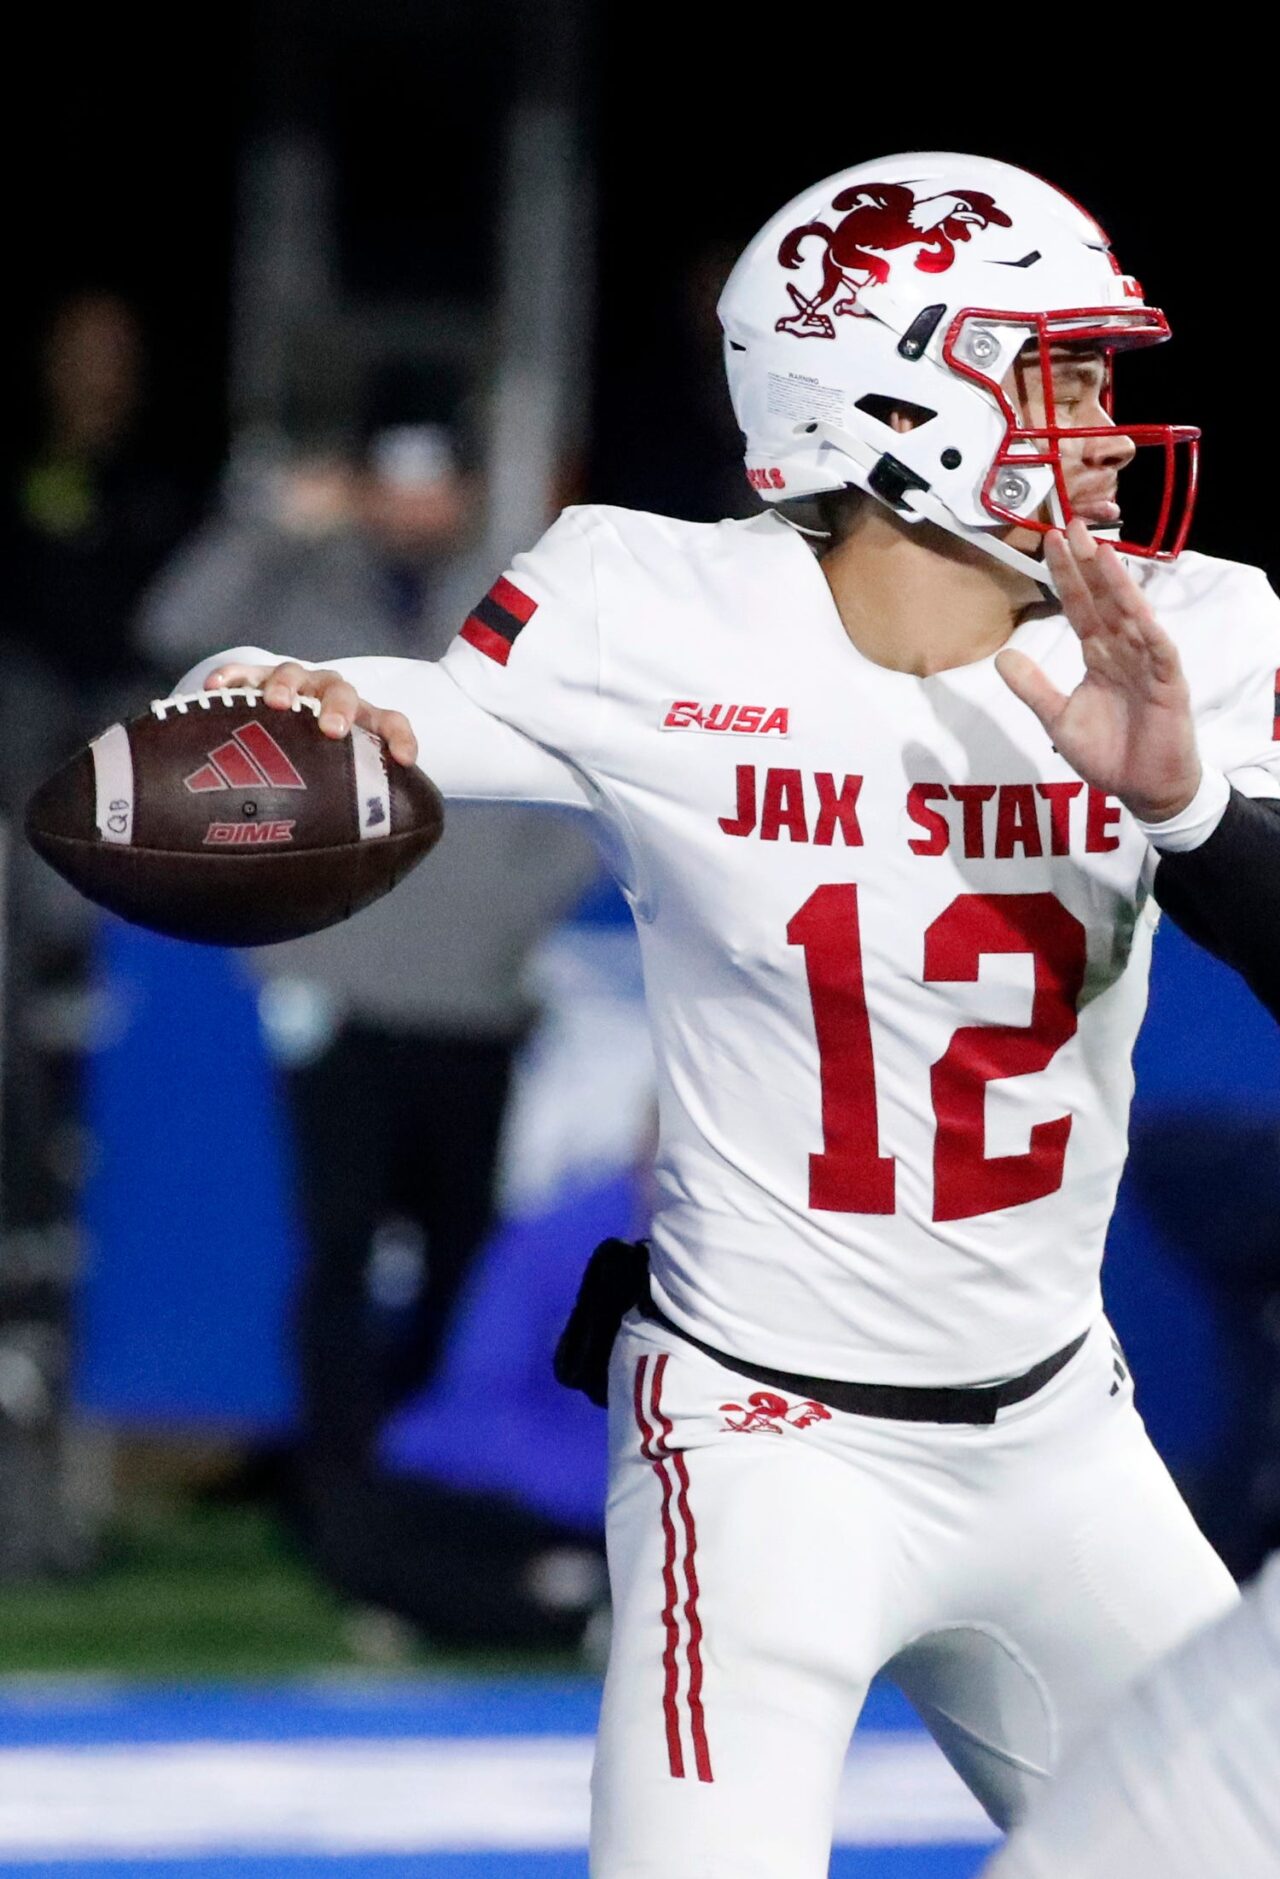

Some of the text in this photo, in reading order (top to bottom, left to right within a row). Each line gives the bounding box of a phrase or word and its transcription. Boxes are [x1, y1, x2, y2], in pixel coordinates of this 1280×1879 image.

[788, 372, 819, 384] WARNING
[107, 799, 129, 833] QB
[717, 764, 1121, 859] JAX STATE
[203, 820, 296, 844] DIME
[786, 882, 1087, 1222] 12
